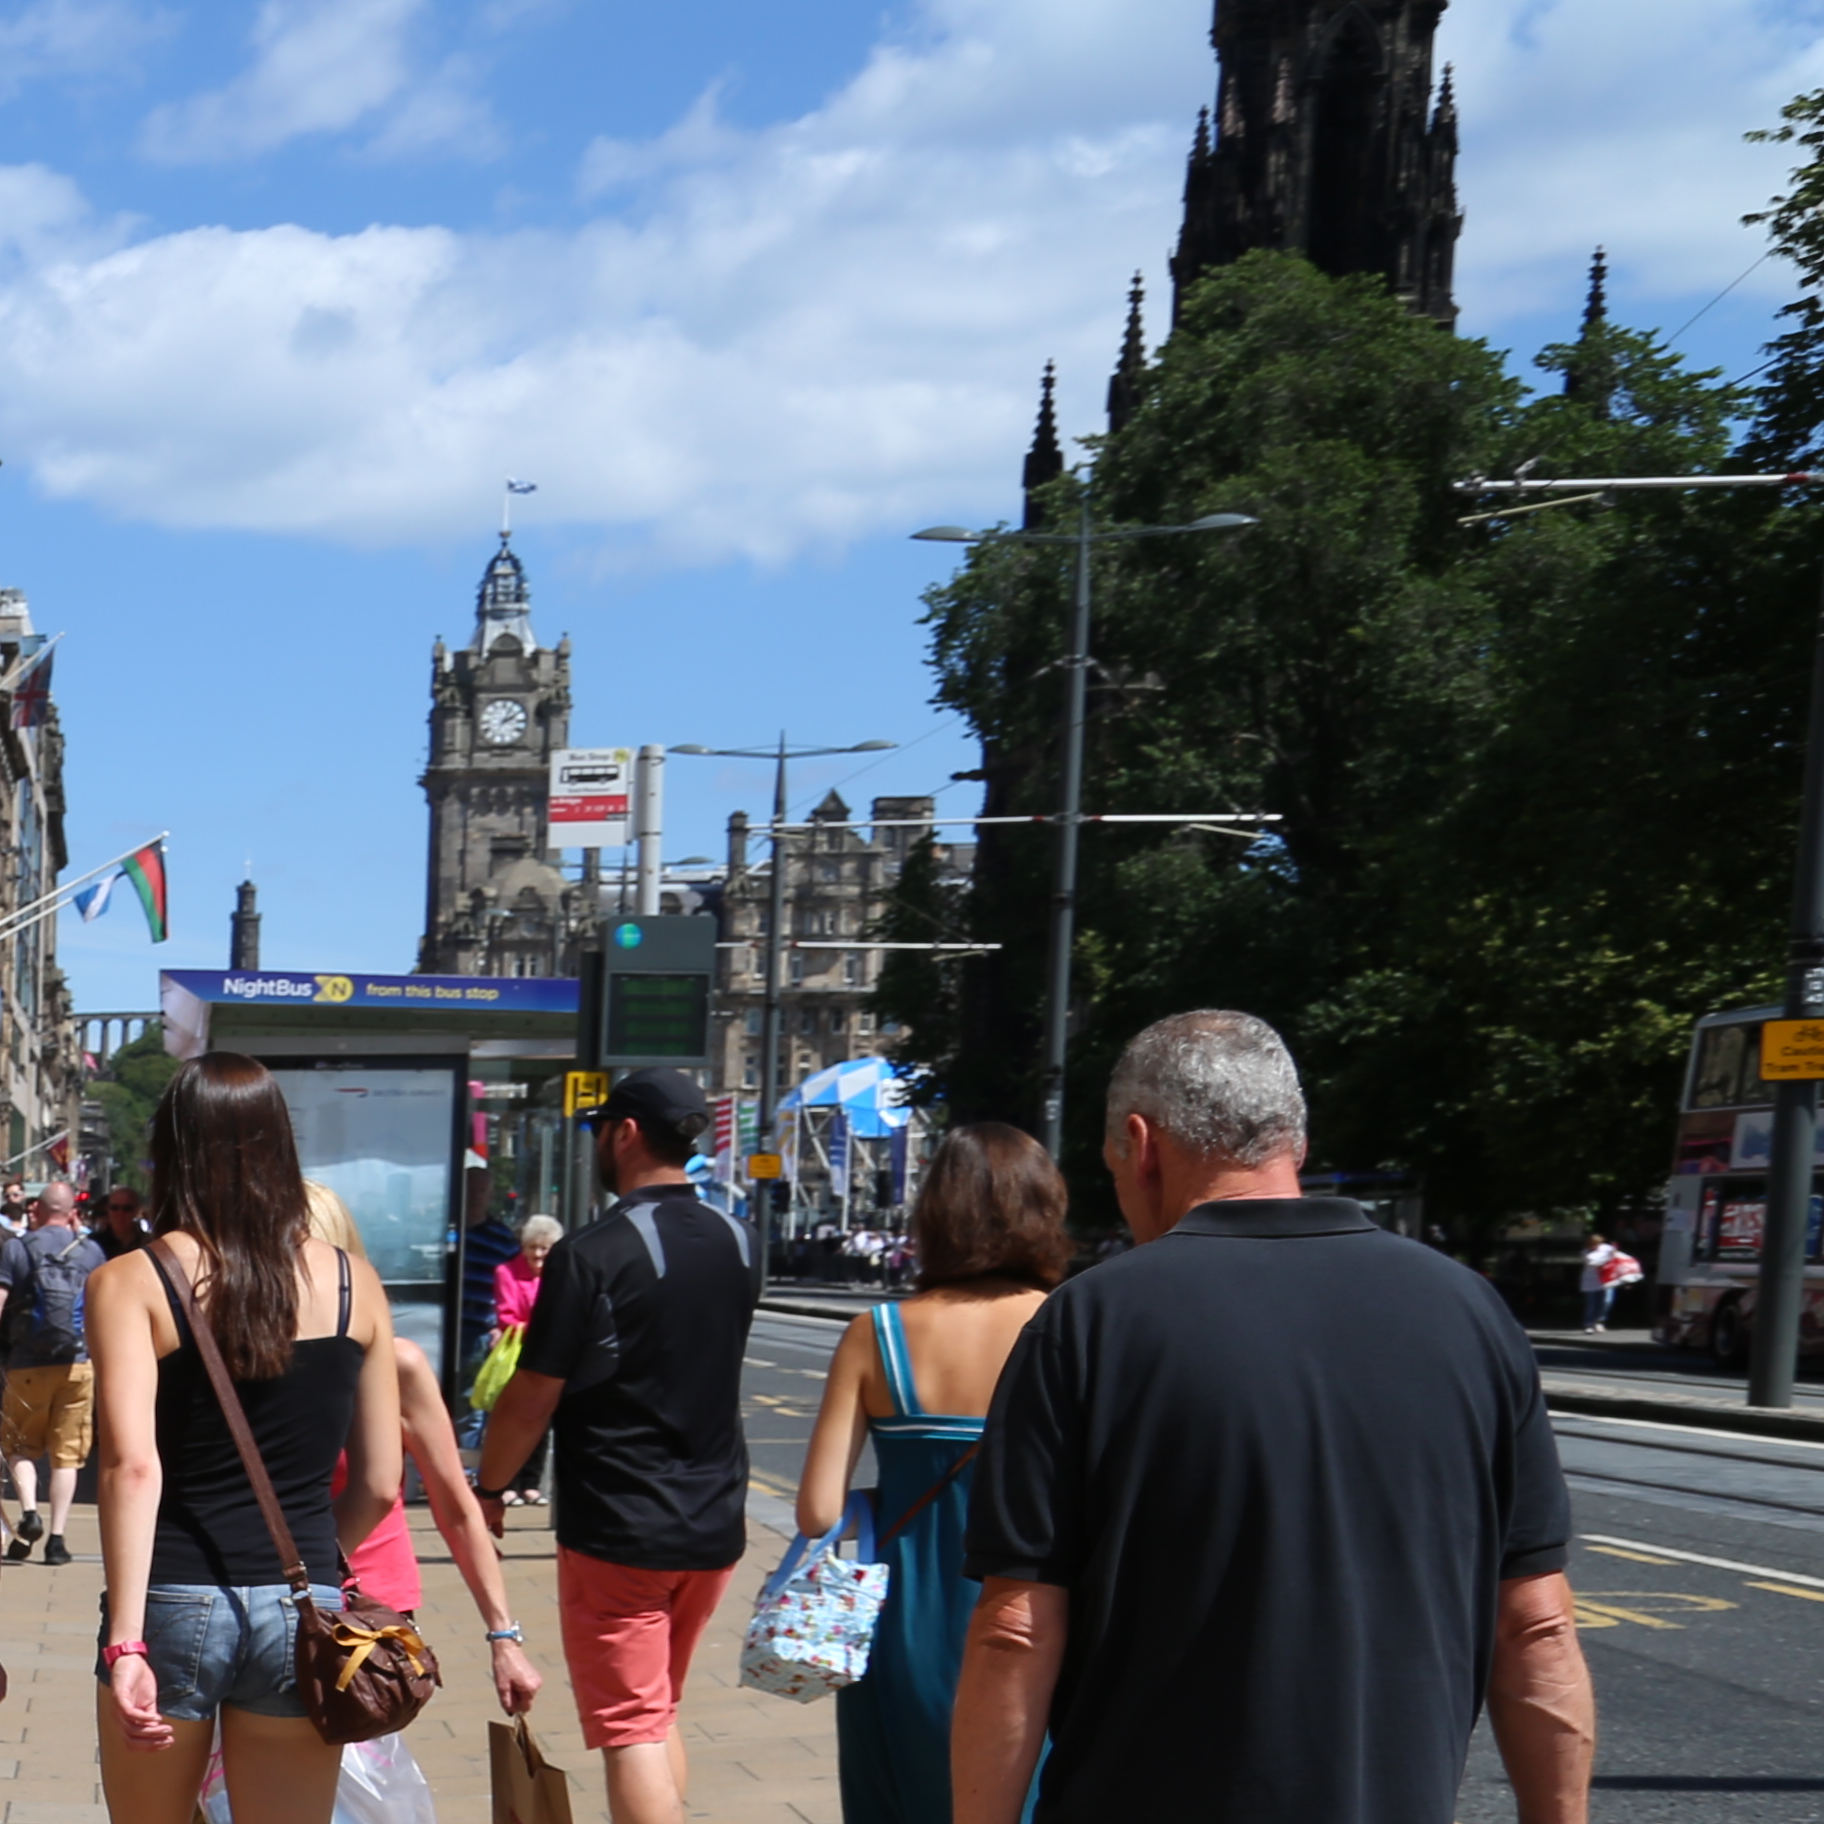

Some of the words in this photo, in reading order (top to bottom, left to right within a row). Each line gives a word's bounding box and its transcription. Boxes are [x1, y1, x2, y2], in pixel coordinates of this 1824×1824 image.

[223, 977, 312, 999] NightBus
[366, 983, 402, 997] from
[405, 984, 432, 998] this
[434, 985, 462, 999] bus
[465, 985, 500, 1001] stop
